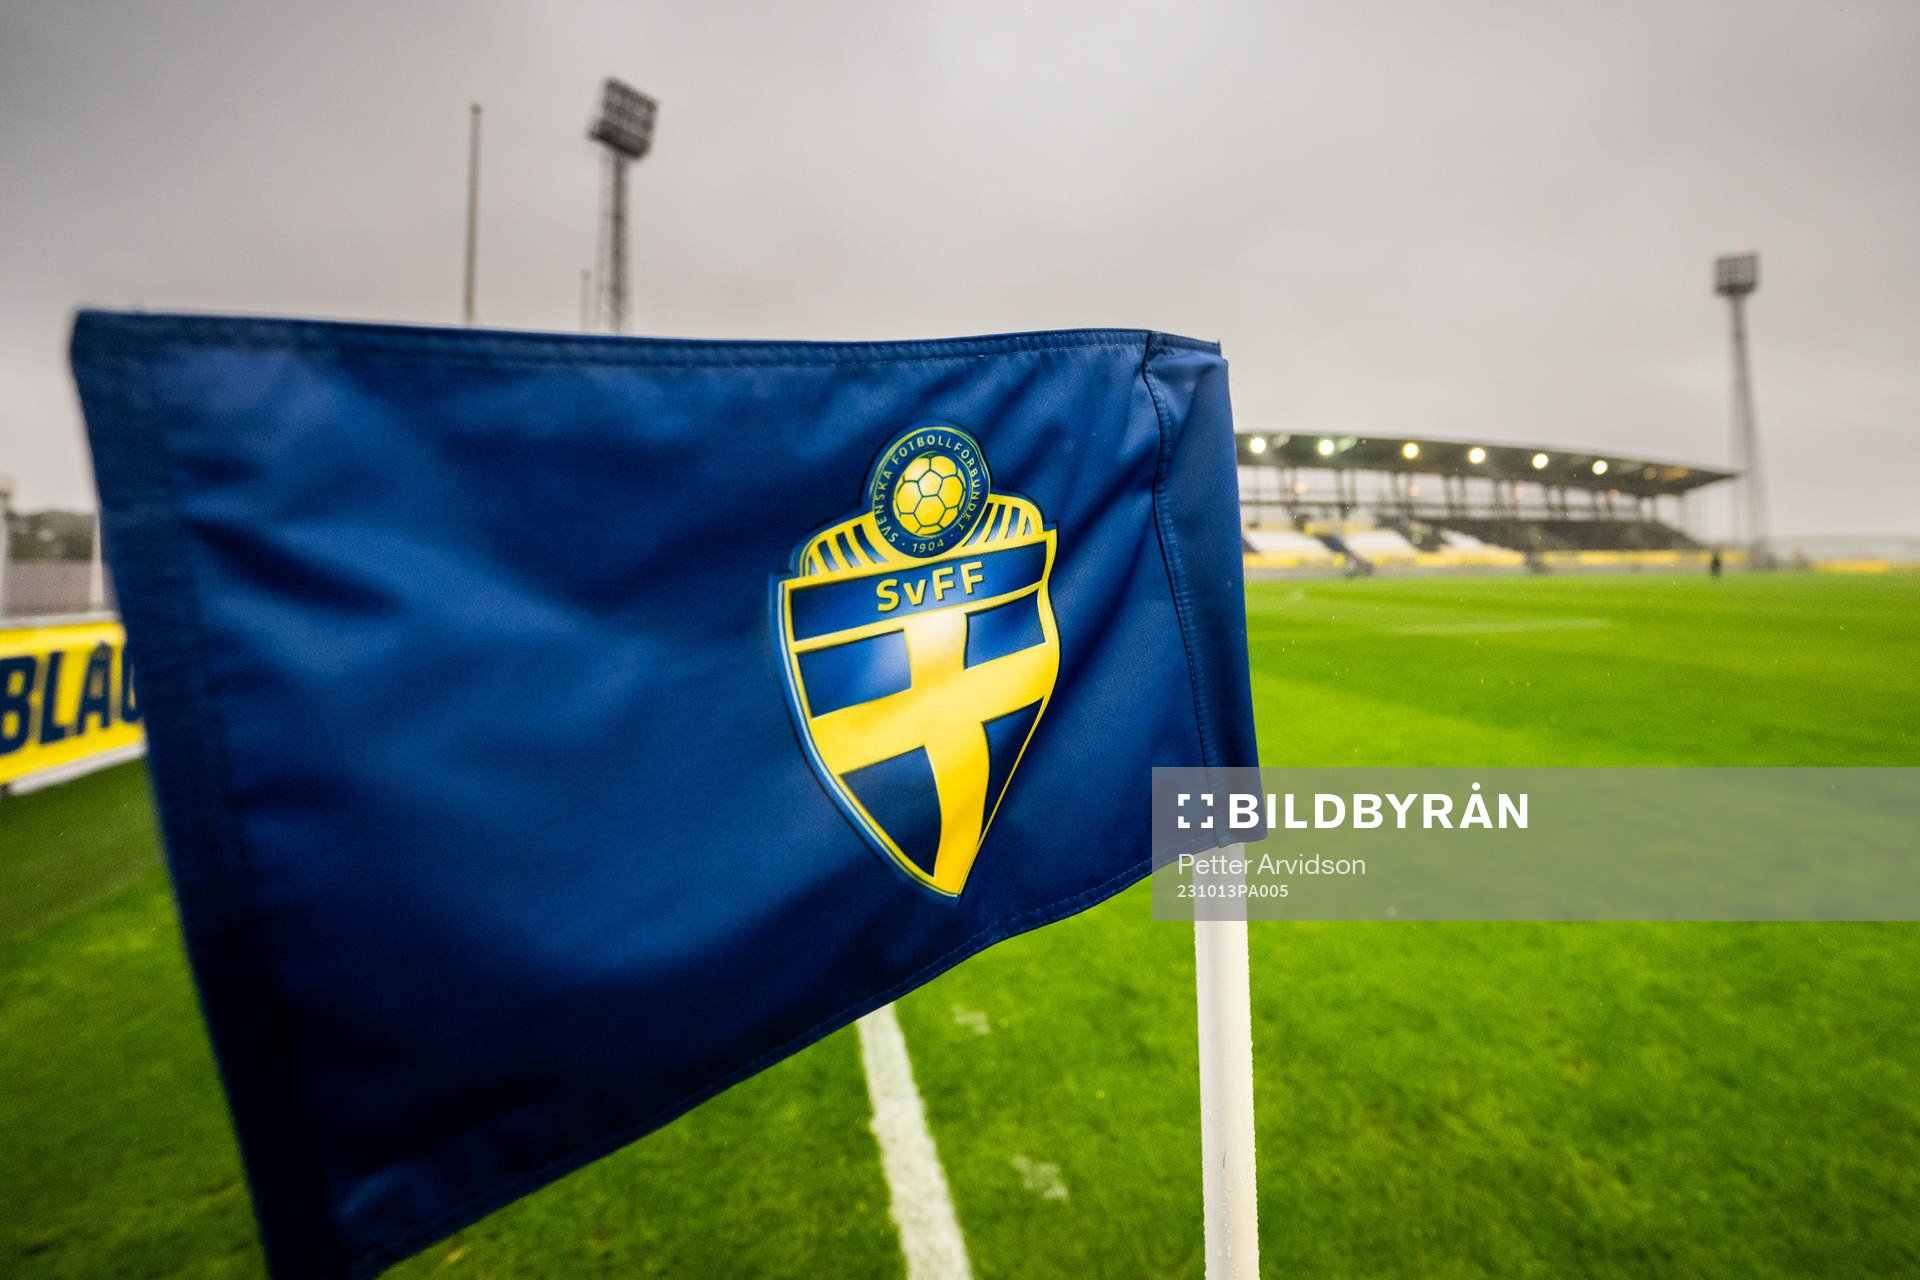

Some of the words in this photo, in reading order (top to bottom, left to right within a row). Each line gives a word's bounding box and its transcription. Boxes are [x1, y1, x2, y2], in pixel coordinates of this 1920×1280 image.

[873, 470, 899, 544] SVENSKA
[912, 538, 945, 554] 1904
[875, 560, 984, 612] SvFF
